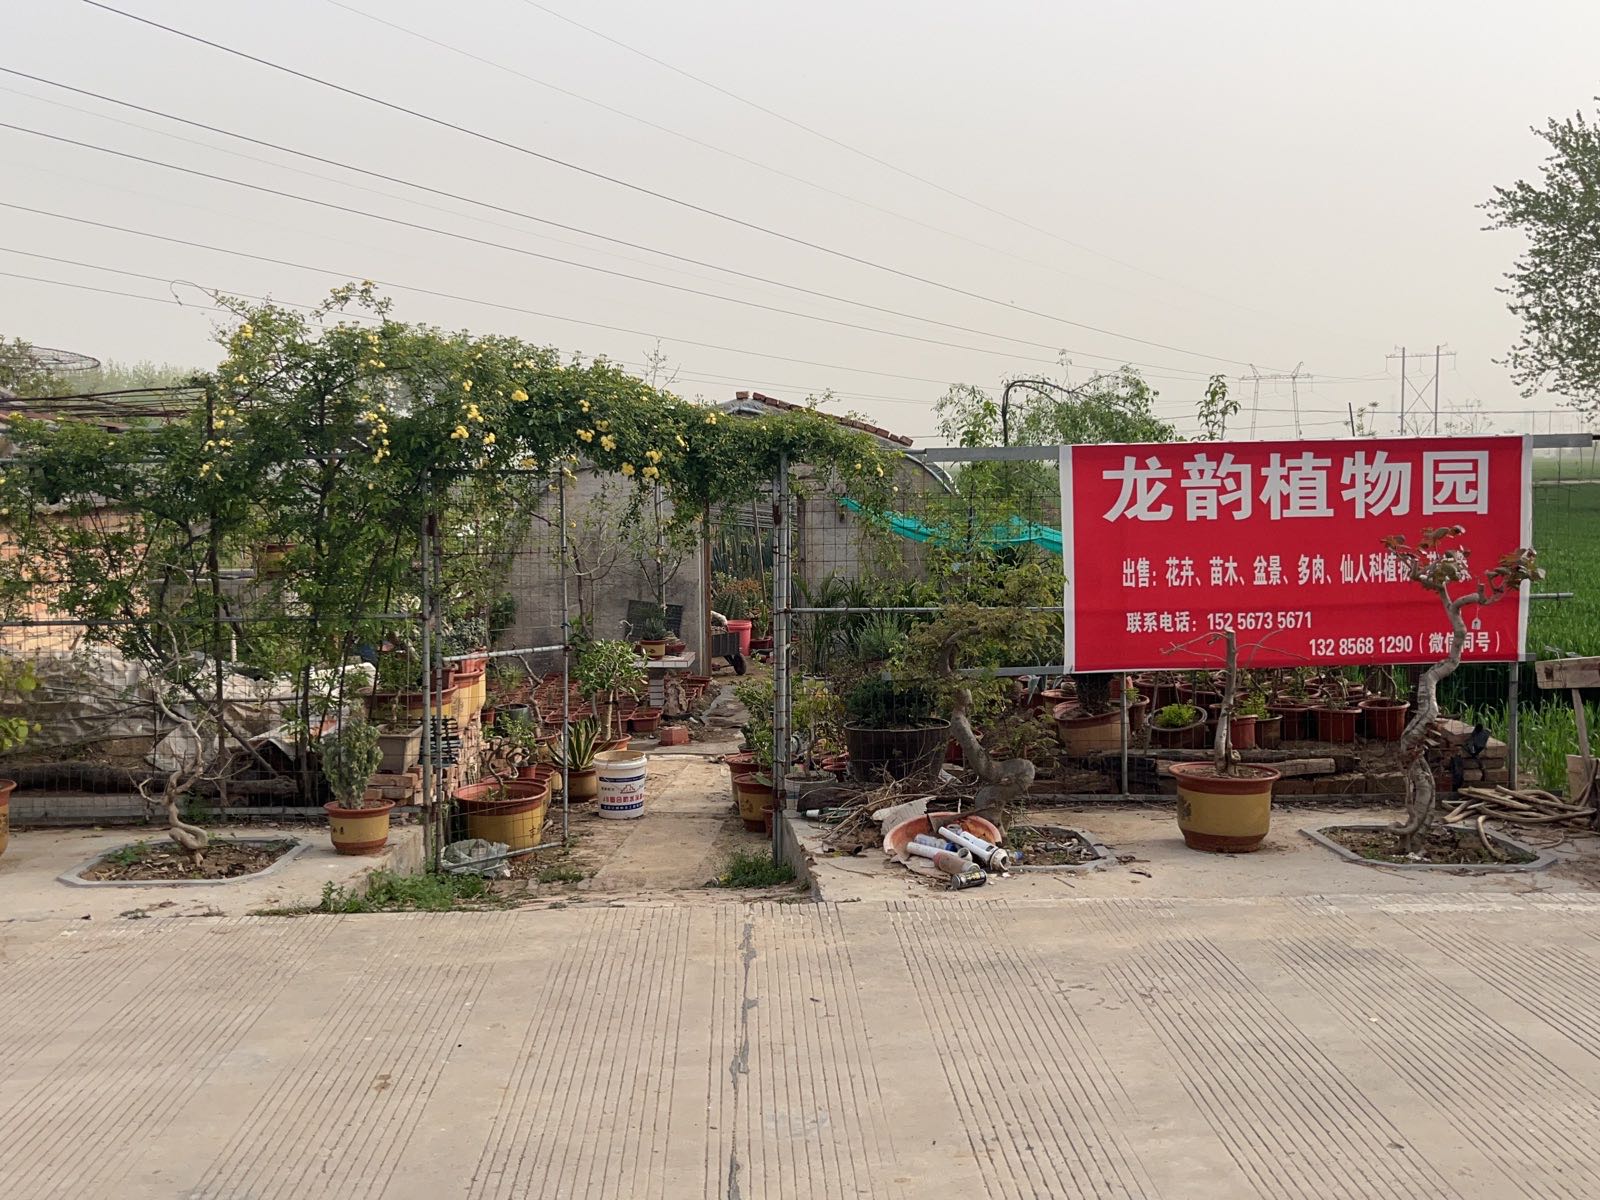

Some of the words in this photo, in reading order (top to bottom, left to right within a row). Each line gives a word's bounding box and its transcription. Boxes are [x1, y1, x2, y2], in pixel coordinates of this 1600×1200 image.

[1102, 450, 1488, 522] 龙韵植物园
[1126, 611, 1196, 634] 联系电话：
[1207, 612, 1233, 631] 152
[1238, 612, 1273, 630] 5673
[1278, 611, 1312, 629] 5671
[1309, 638, 1335, 656] 132
[1339, 637, 1374, 656] 8568
[1379, 636, 1413, 654] 1290
